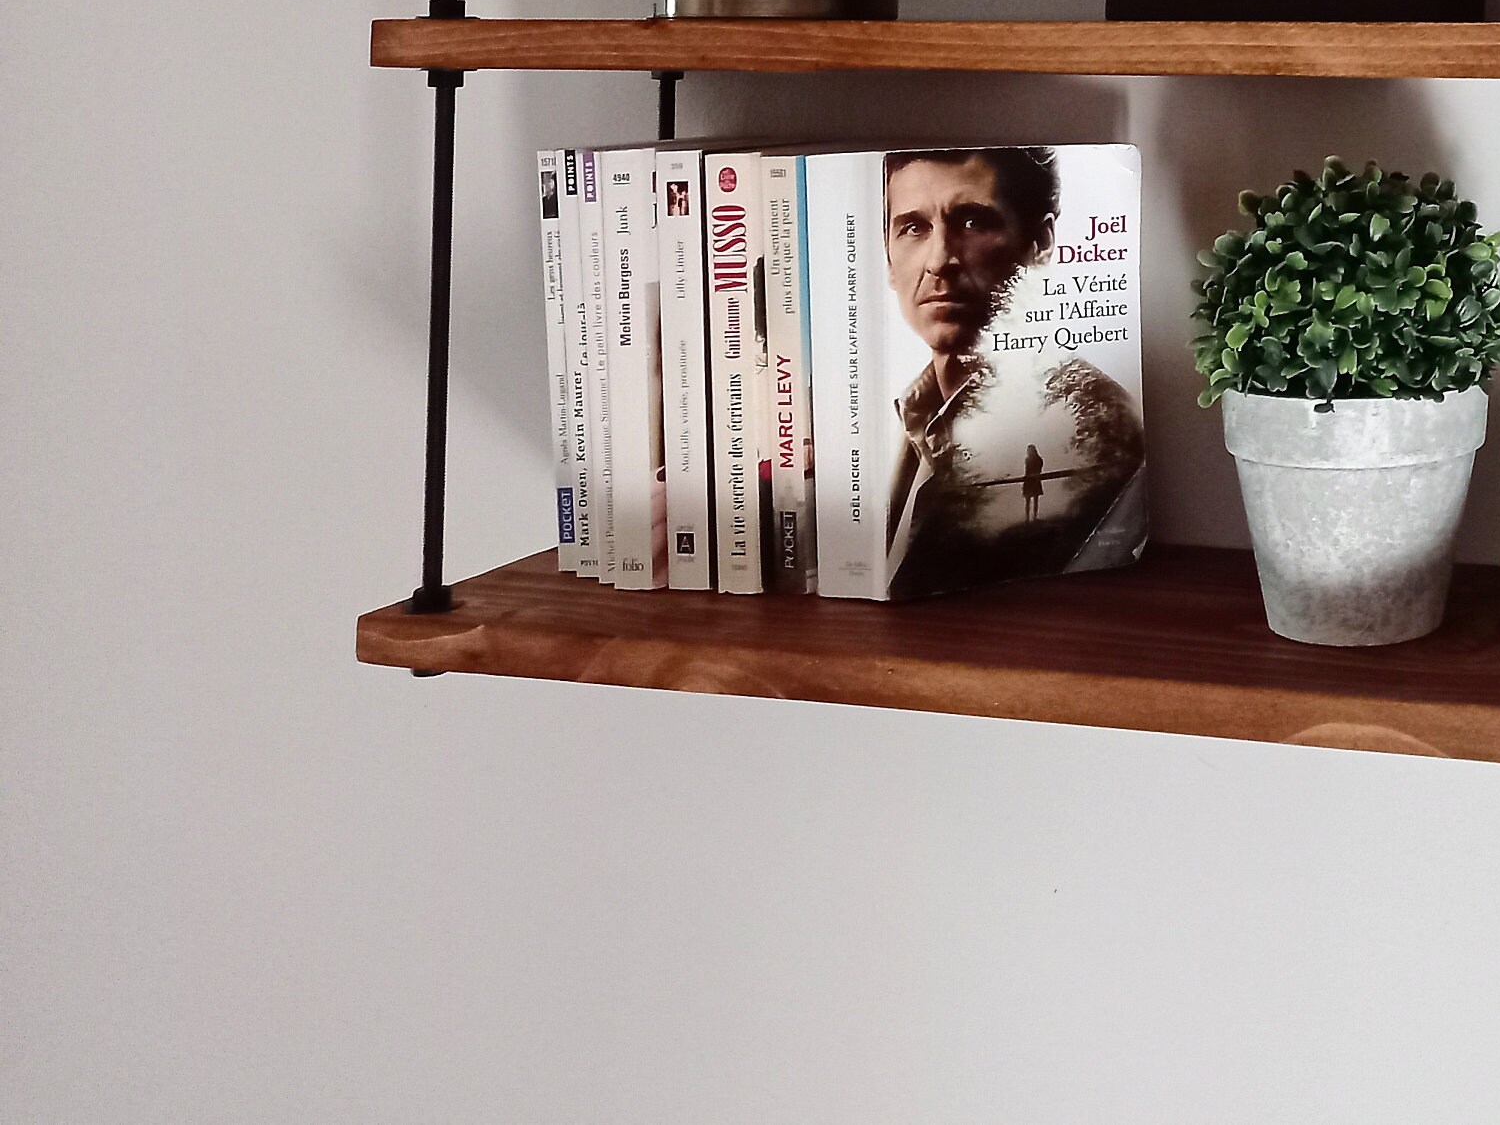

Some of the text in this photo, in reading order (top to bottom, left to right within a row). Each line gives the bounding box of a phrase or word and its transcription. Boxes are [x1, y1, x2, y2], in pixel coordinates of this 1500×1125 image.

[567, 154, 577, 192] POINTS
[586, 161, 596, 199] POINTS
[612, 173, 630, 182] 4940
[617, 205, 632, 236] Junk
[770, 199, 780, 276] Un sentiment
[1085, 215, 1128, 241] Joël
[546, 231, 558, 301] Les gens heureux
[676, 240, 686, 299] Lilly Linder
[712, 204, 749, 293] MUSSO
[782, 198, 795, 314] plus fort que la peur
[1056, 244, 1128, 265] Dicker
[591, 231, 606, 372] Le petit livre des couleurs
[617, 248, 632, 347] Melvin Burgess
[1042, 272, 1128, 297] La Vérité
[724, 297, 741, 359] Guillaume
[846, 212, 860, 435] LA VÉRITÉ SUR L'AFFAIRE HARRY QUEBERT
[1025, 300, 1128, 324] sur l’Affaire
[993, 327, 1129, 354] Harry Quebert
[678, 339, 690, 389] prostituée
[574, 371, 584, 418] Maurer
[679, 390, 690, 425] violée,
[727, 373, 742, 432] écrivains
[776, 353, 795, 468] MARC LEVY
[557, 373, 570, 465] Agnès Martin-Lugand
[576, 423, 586, 462] Kevin
[729, 437, 743, 458] des
[578, 467, 589, 508] Owen,
[599, 377, 616, 572] Michel Pastoureau Dominique Simonnet
[729, 463, 745, 511] secrète
[850, 449, 861, 524] JOËL DICKER
[579, 513, 590, 547] Mark
[731, 516, 745, 535] vie
[622, 558, 645, 572] folio
[731, 540, 746, 557] La
